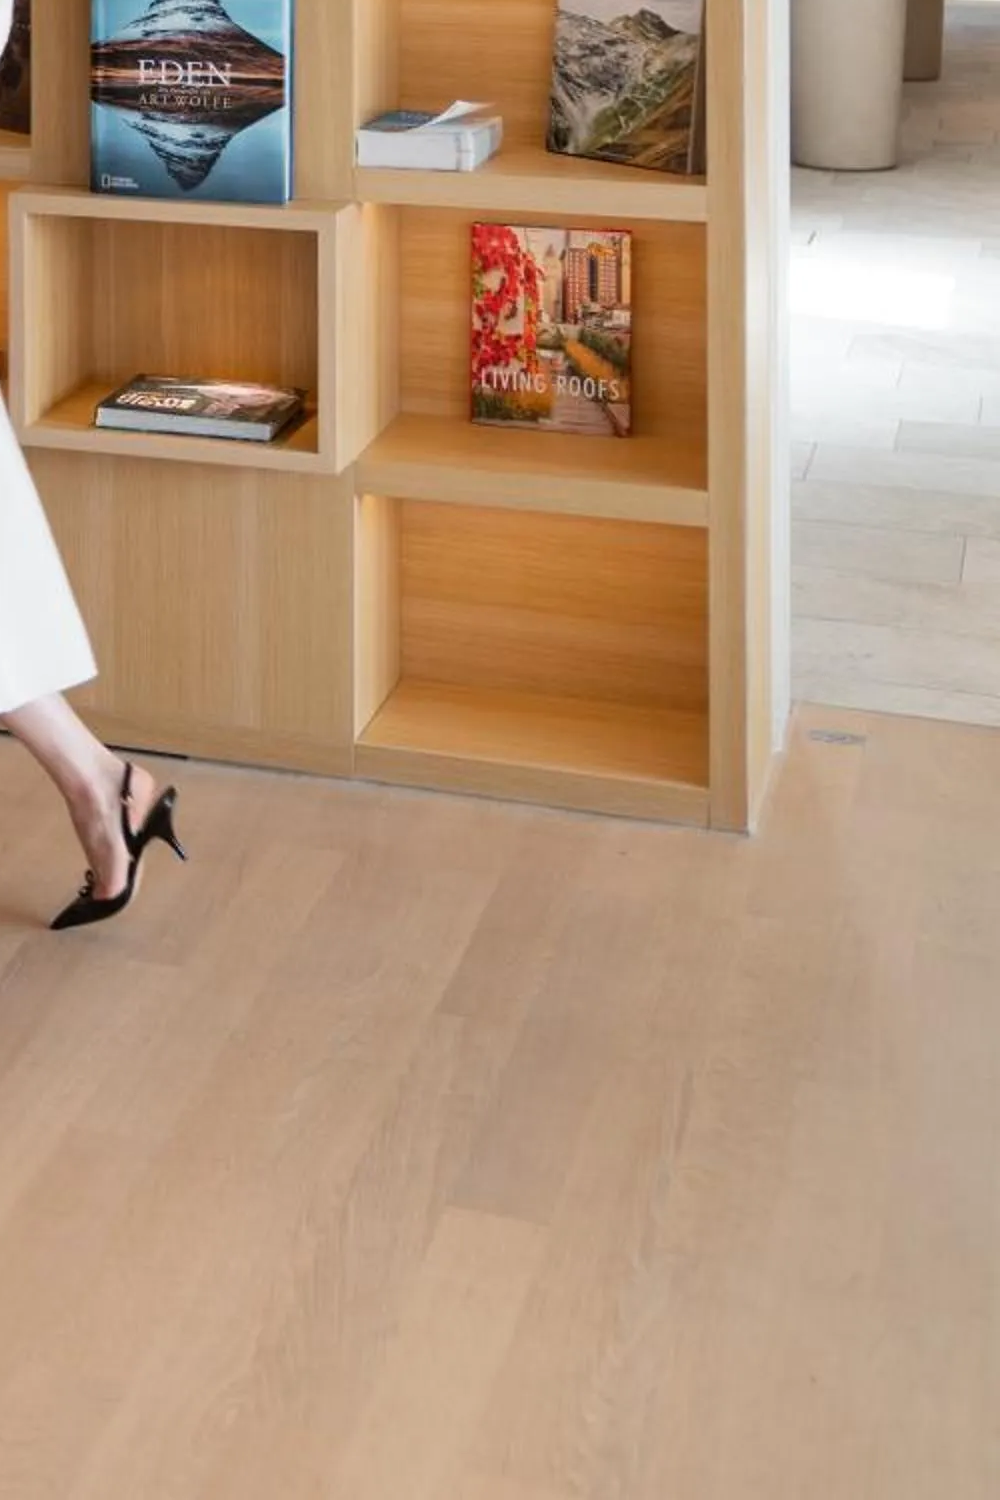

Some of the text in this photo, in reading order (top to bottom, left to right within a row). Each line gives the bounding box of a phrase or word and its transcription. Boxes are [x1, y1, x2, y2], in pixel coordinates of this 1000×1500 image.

[138, 59, 233, 88] EDEN
[481, 368, 621, 400] LIVING ROOFS
